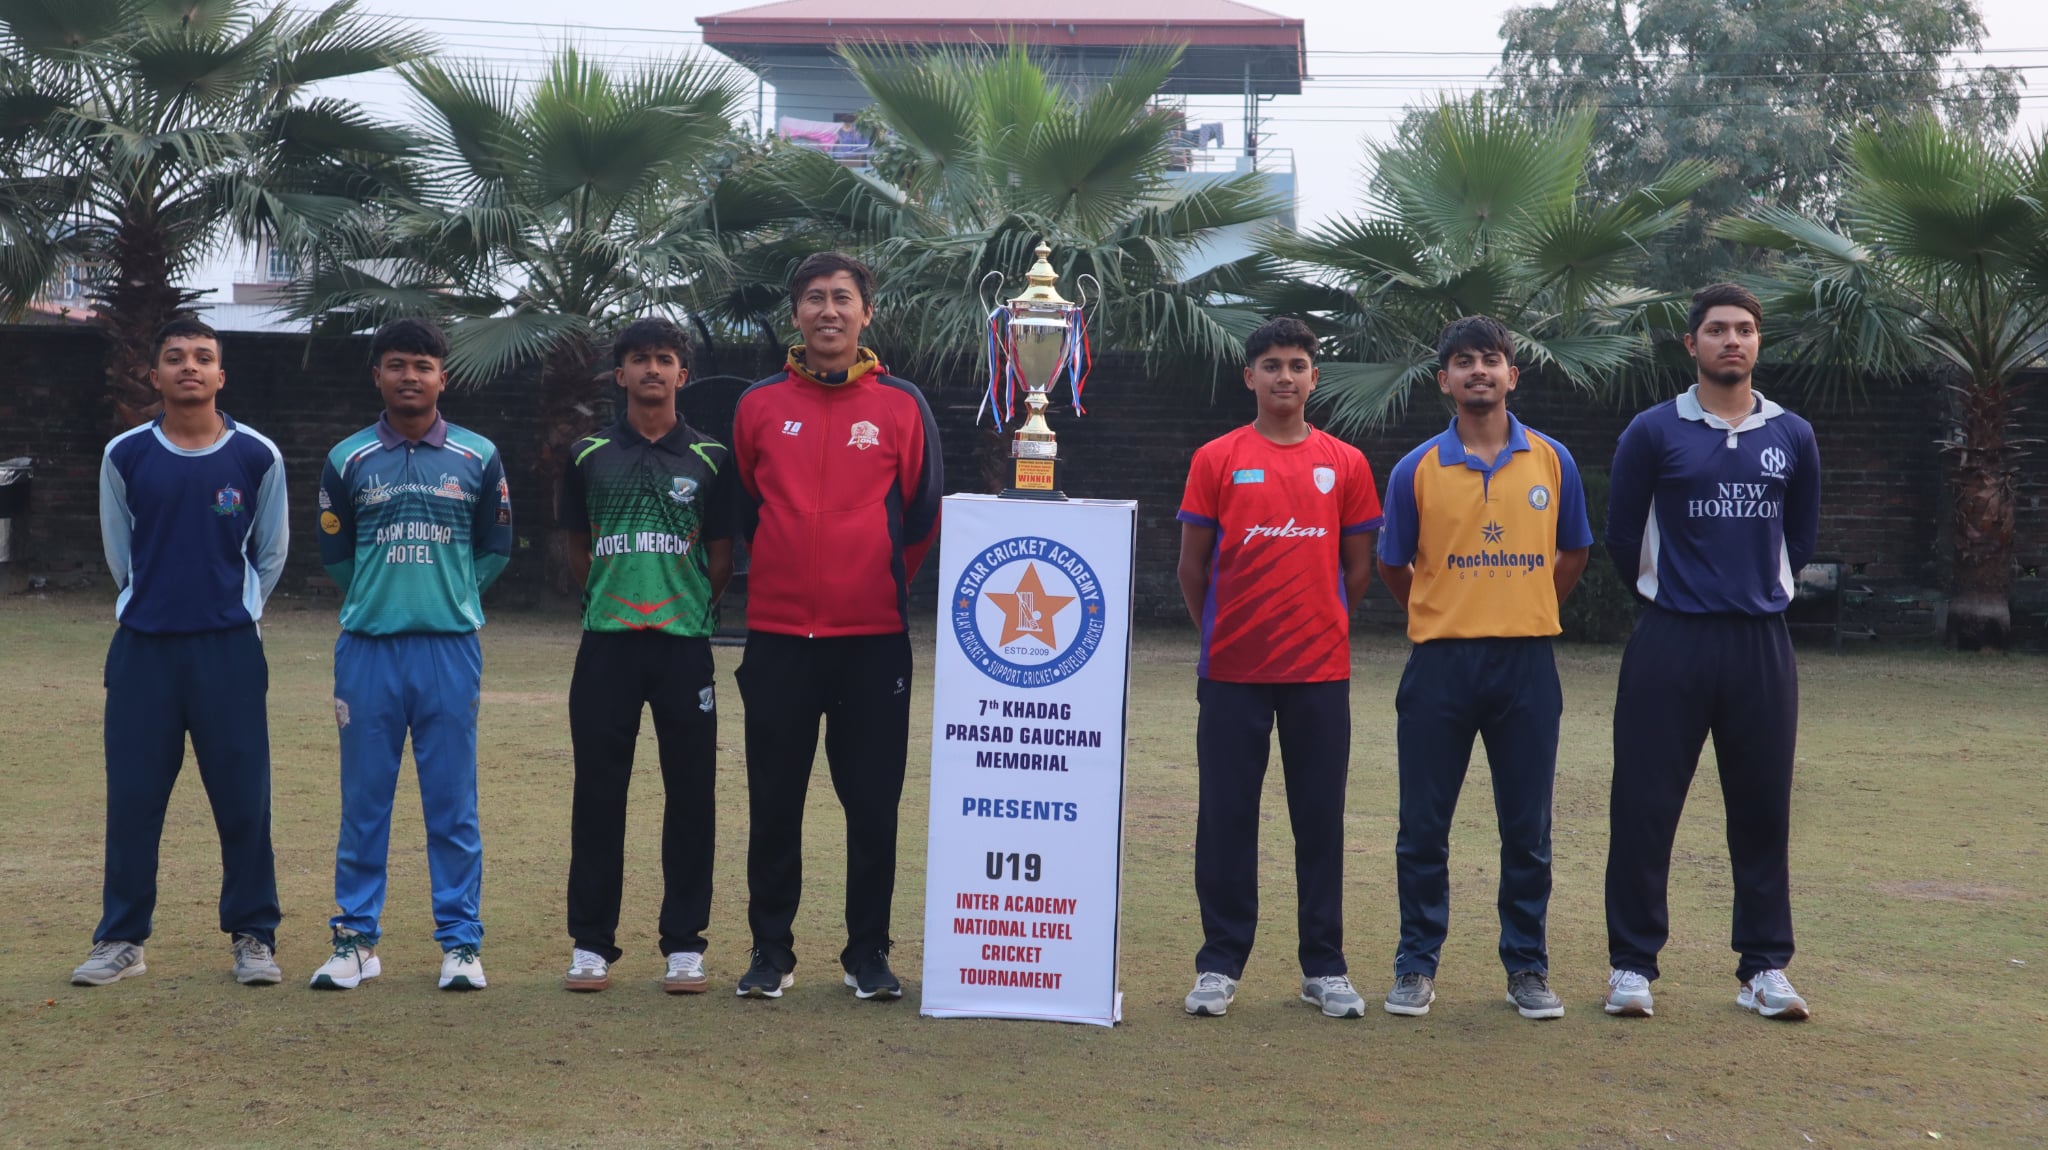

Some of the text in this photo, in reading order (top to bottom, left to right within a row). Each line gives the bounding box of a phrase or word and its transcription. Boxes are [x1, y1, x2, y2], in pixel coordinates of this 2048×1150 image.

[1018, 474, 1052, 483] WINNER
[1717, 482, 1769, 500] NEW
[1688, 500, 1780, 518] HORIZON
[386, 545, 434, 564] HOTEL
[595, 533, 632, 557] HOTEL
[960, 539, 1100, 601] STAR CRICKET ACADEMY
[1447, 549, 1545, 572] Panchakanya
[1459, 570, 1528, 580] GROUP
[955, 612, 1104, 686] PLAY CRICKET SUPPORT CRICKET DEVELOP CRICKET
[1004, 646, 1050, 657] ESTD.2009
[978, 700, 1072, 721] 7th KHADAG
[945, 723, 1102, 748] PRASAD GAUCHAN
[976, 751, 1069, 772] MEMORIAL
[962, 797, 1078, 822] PRESENTS
[986, 851, 1042, 882] U19
[956, 892, 1077, 916] INTER ACADEMY
[953, 917, 1073, 941] NATIONAL LEVEL
[981, 943, 1043, 964] CRICKET
[959, 967, 1063, 990] TOURNAMENT
